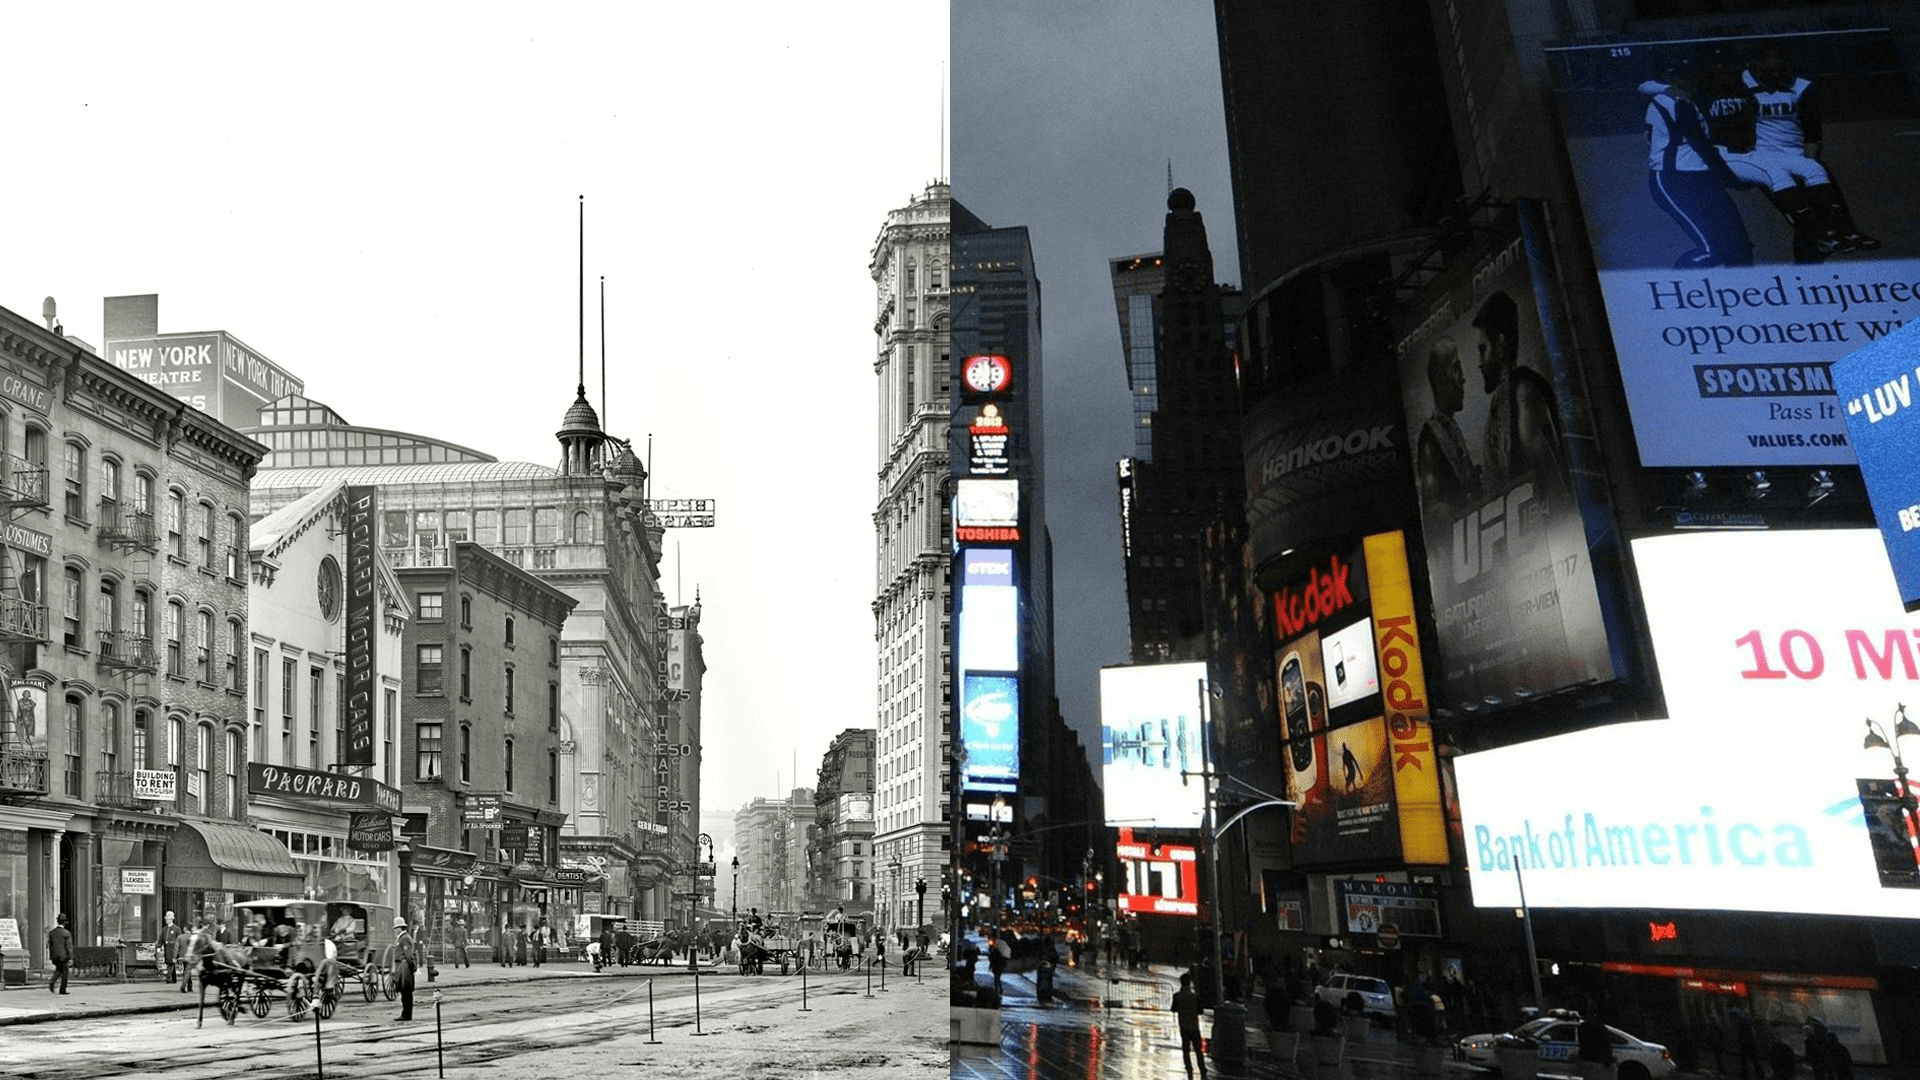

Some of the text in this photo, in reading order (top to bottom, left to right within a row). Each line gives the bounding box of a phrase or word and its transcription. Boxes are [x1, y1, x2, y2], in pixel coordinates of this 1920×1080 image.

[1647, 275, 1789, 316] Helped
[1662, 317, 1849, 354] opponent
[115, 344, 212, 369] NEW YORK
[224, 344, 246, 376] NEW
[245, 354, 269, 391] YORK
[1702, 366, 1834, 394] SPORTSM
[1768, 401, 1836, 421] Pass It
[1746, 433, 1848, 448] VALUES.COM
[957, 527, 1020, 541] TOSHIBA
[1453, 482, 1534, 583] UFC
[1272, 554, 1353, 640] Kodak
[350, 494, 371, 751] PACKARD MOTOR CARS
[1735, 628, 1825, 681] 10
[657, 647, 668, 700] YORK
[668, 689, 691, 701] 75
[1377, 615, 1430, 773] Kodak
[657, 715, 668, 813] THEATRE
[668, 744, 691, 756] 50
[136, 771, 174, 780] BUILDING
[136, 779, 174, 788] TO RENT
[262, 767, 361, 799] PACKARD
[668, 801, 691, 812] 25
[352, 830, 391, 842] MOTOR CARS
[1474, 805, 1816, 871] Bank of America
